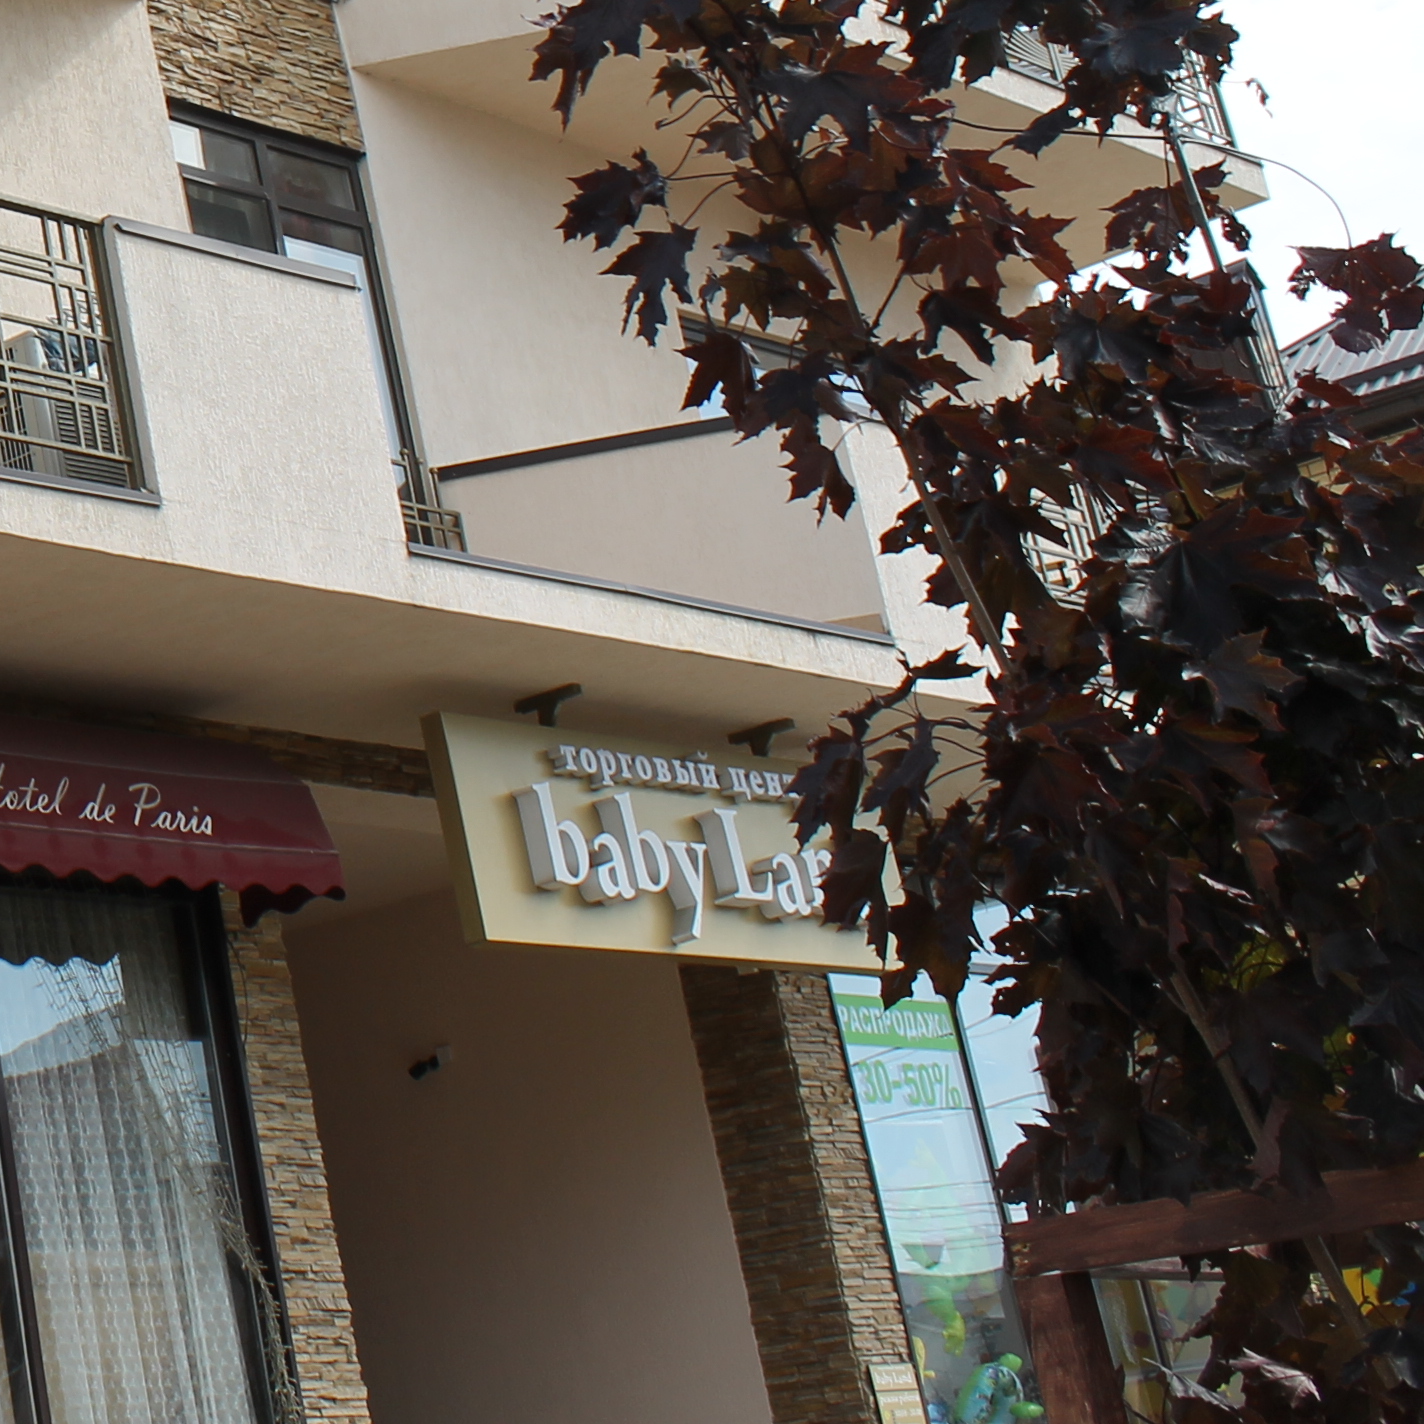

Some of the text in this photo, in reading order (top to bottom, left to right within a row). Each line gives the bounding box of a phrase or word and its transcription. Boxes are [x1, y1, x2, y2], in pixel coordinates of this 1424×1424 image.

[558, 743, 721, 790] торговый
[78, 782, 117, 825] de
[128, 782, 214, 836] Paris
[836, 1003, 955, 1042] РАСПРОДАЖА
[856, 1059, 964, 1108] 30-50%
